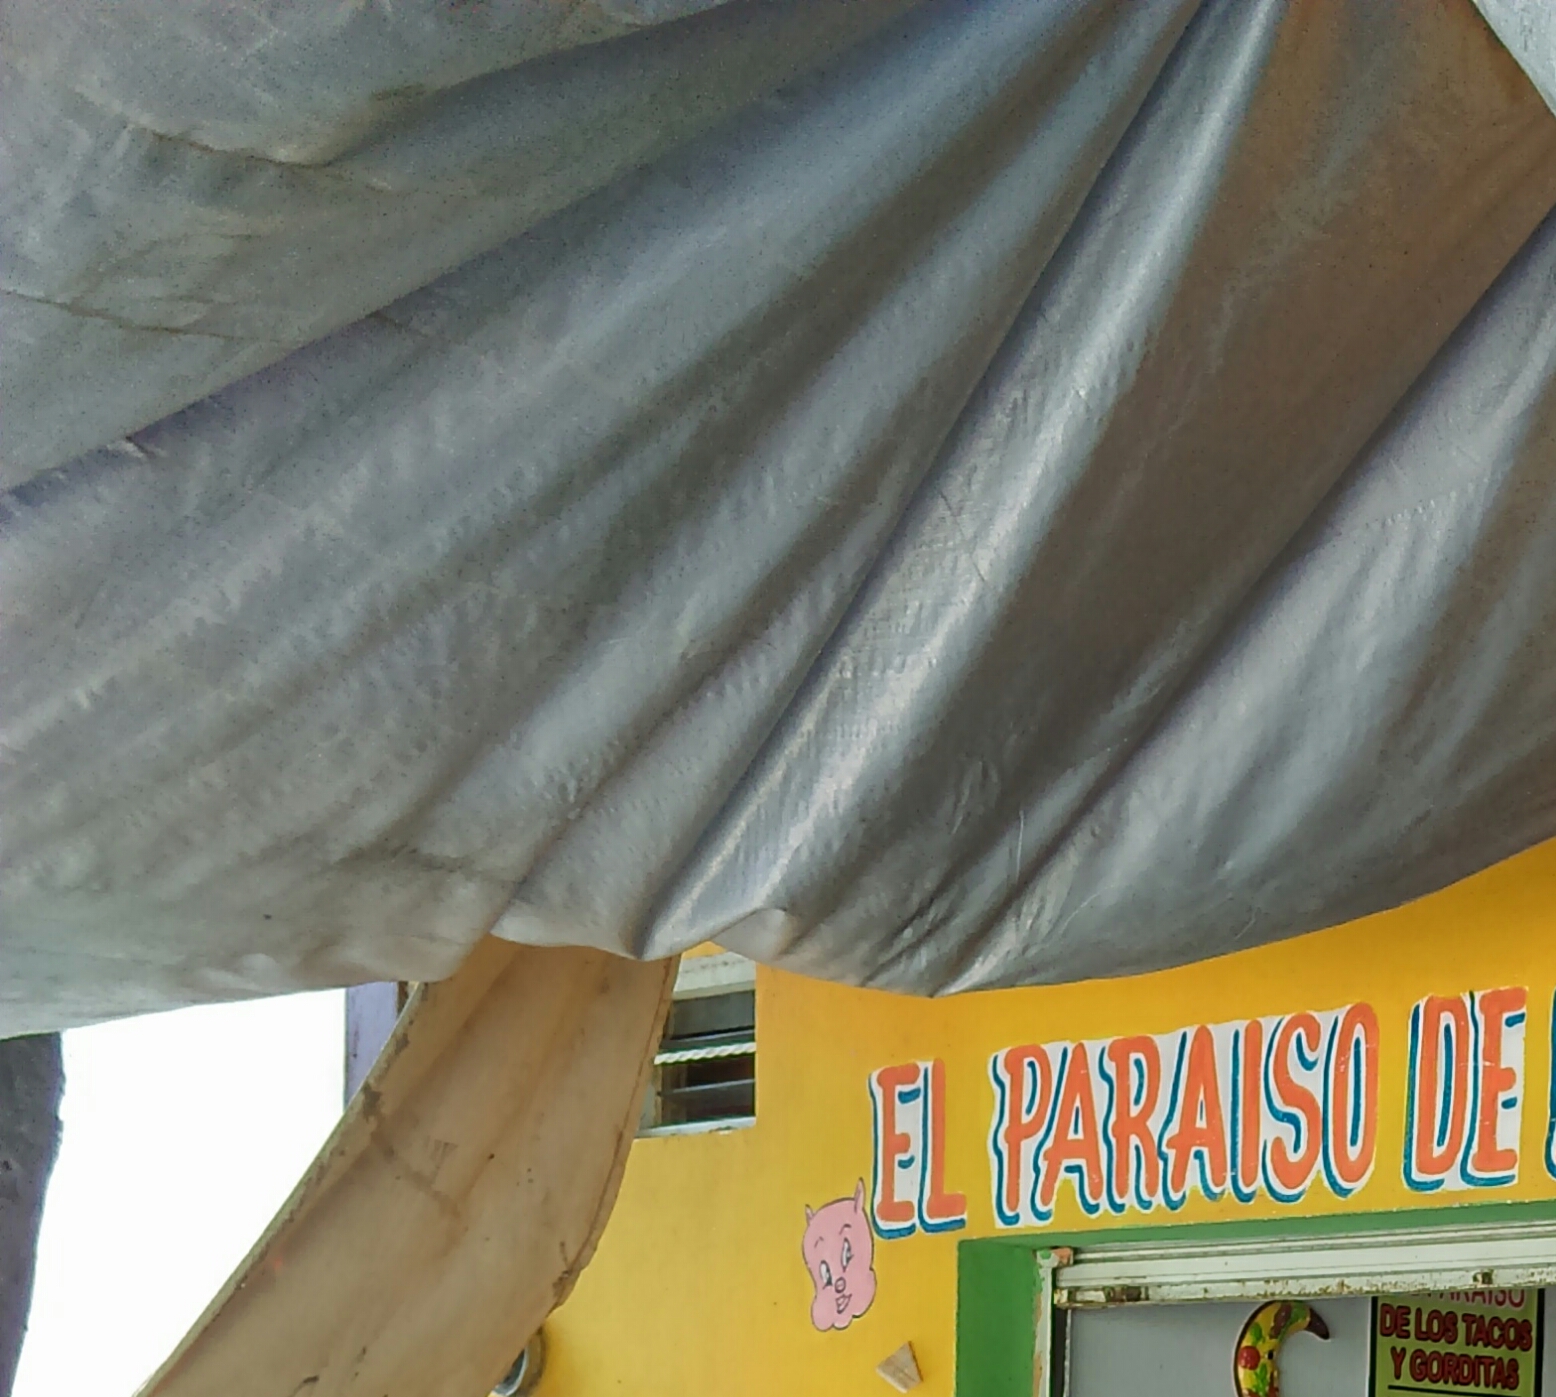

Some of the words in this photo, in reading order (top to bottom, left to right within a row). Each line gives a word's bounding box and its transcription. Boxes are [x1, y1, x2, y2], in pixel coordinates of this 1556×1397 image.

[870, 1058, 966, 1238] EL
[991, 1001, 1380, 1226] PARAISO
[1403, 988, 1528, 1190] DE
[1379, 1302, 1411, 1339] DE
[1414, 1307, 1459, 1344] LOS
[1461, 1312, 1533, 1352] TACOS
[1390, 1345, 1407, 1380] Y
[1409, 1348, 1520, 1391] GORDITAS
